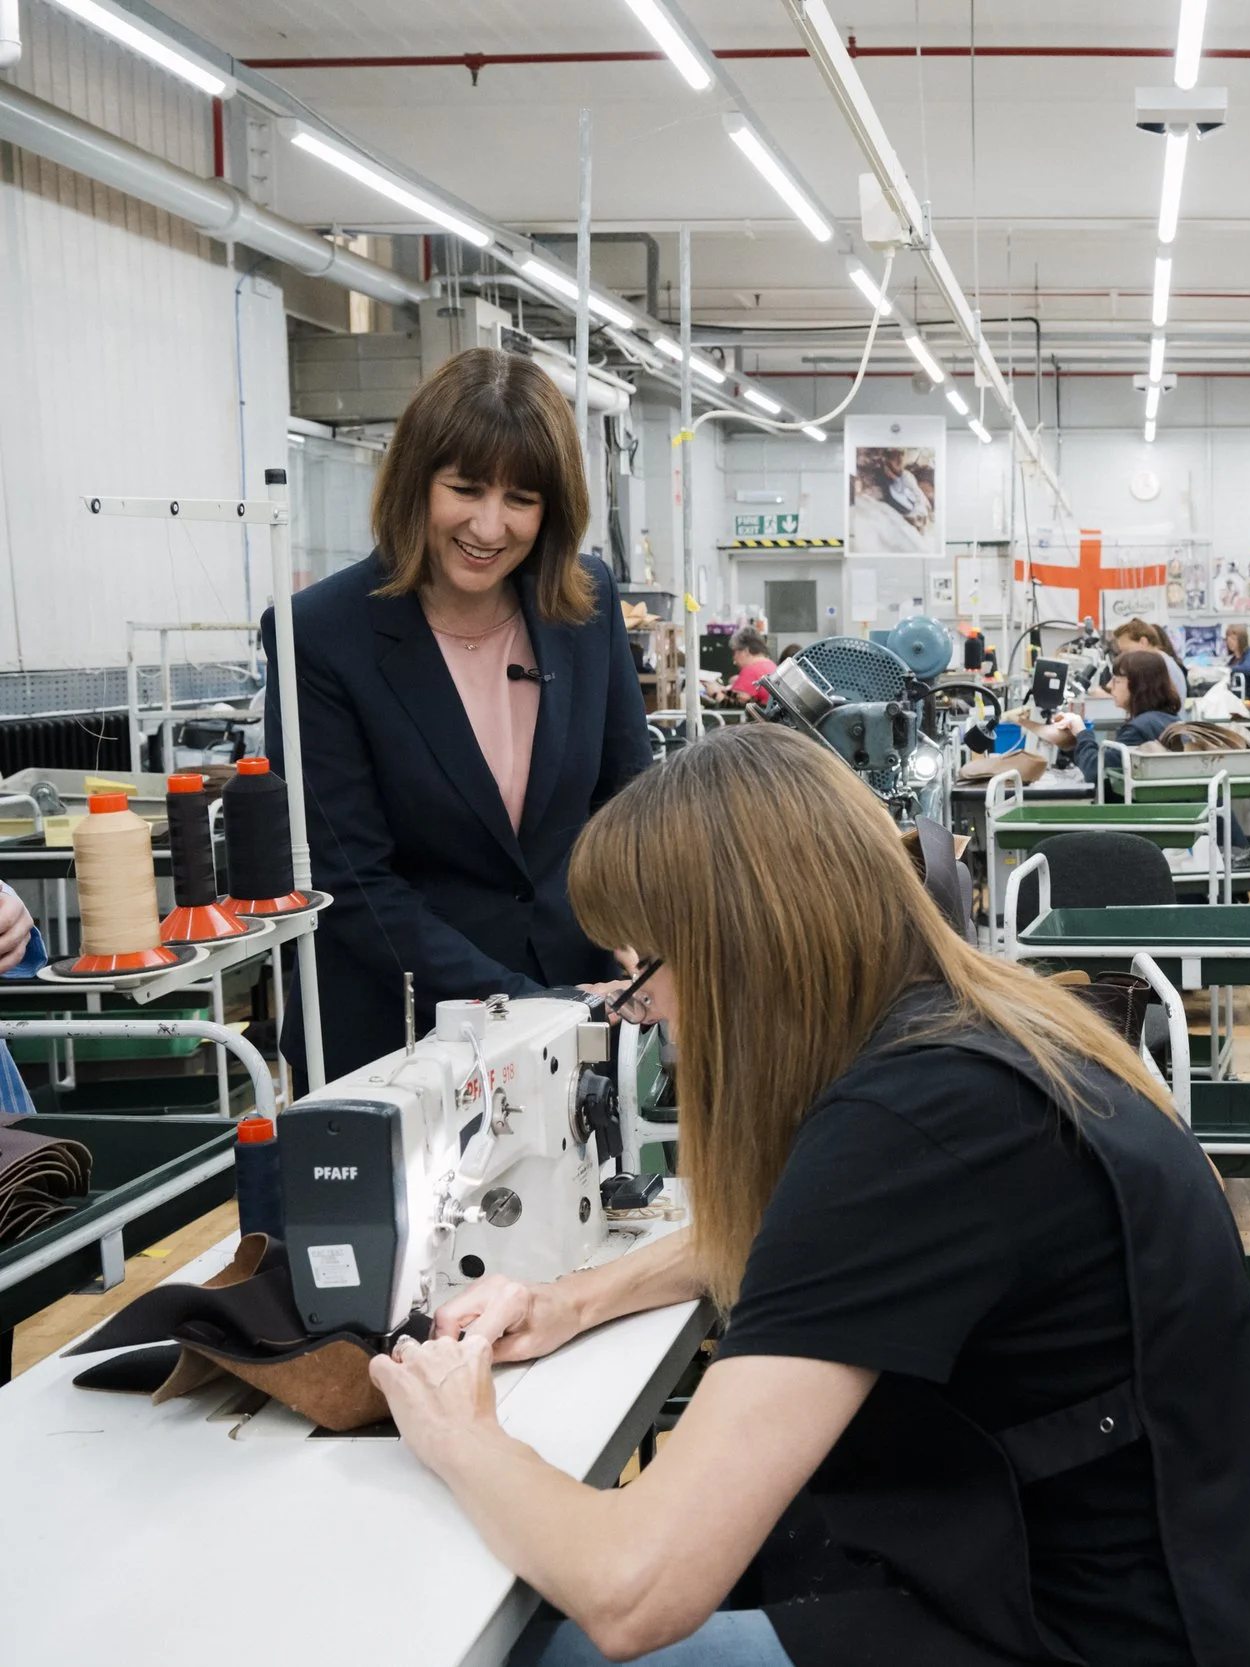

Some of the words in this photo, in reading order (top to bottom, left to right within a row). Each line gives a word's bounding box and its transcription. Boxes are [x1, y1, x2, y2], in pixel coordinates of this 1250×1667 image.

[737, 515, 759, 525] FIRE
[737, 526, 759, 535] EXIT
[313, 1166, 359, 1181] PFAFF
